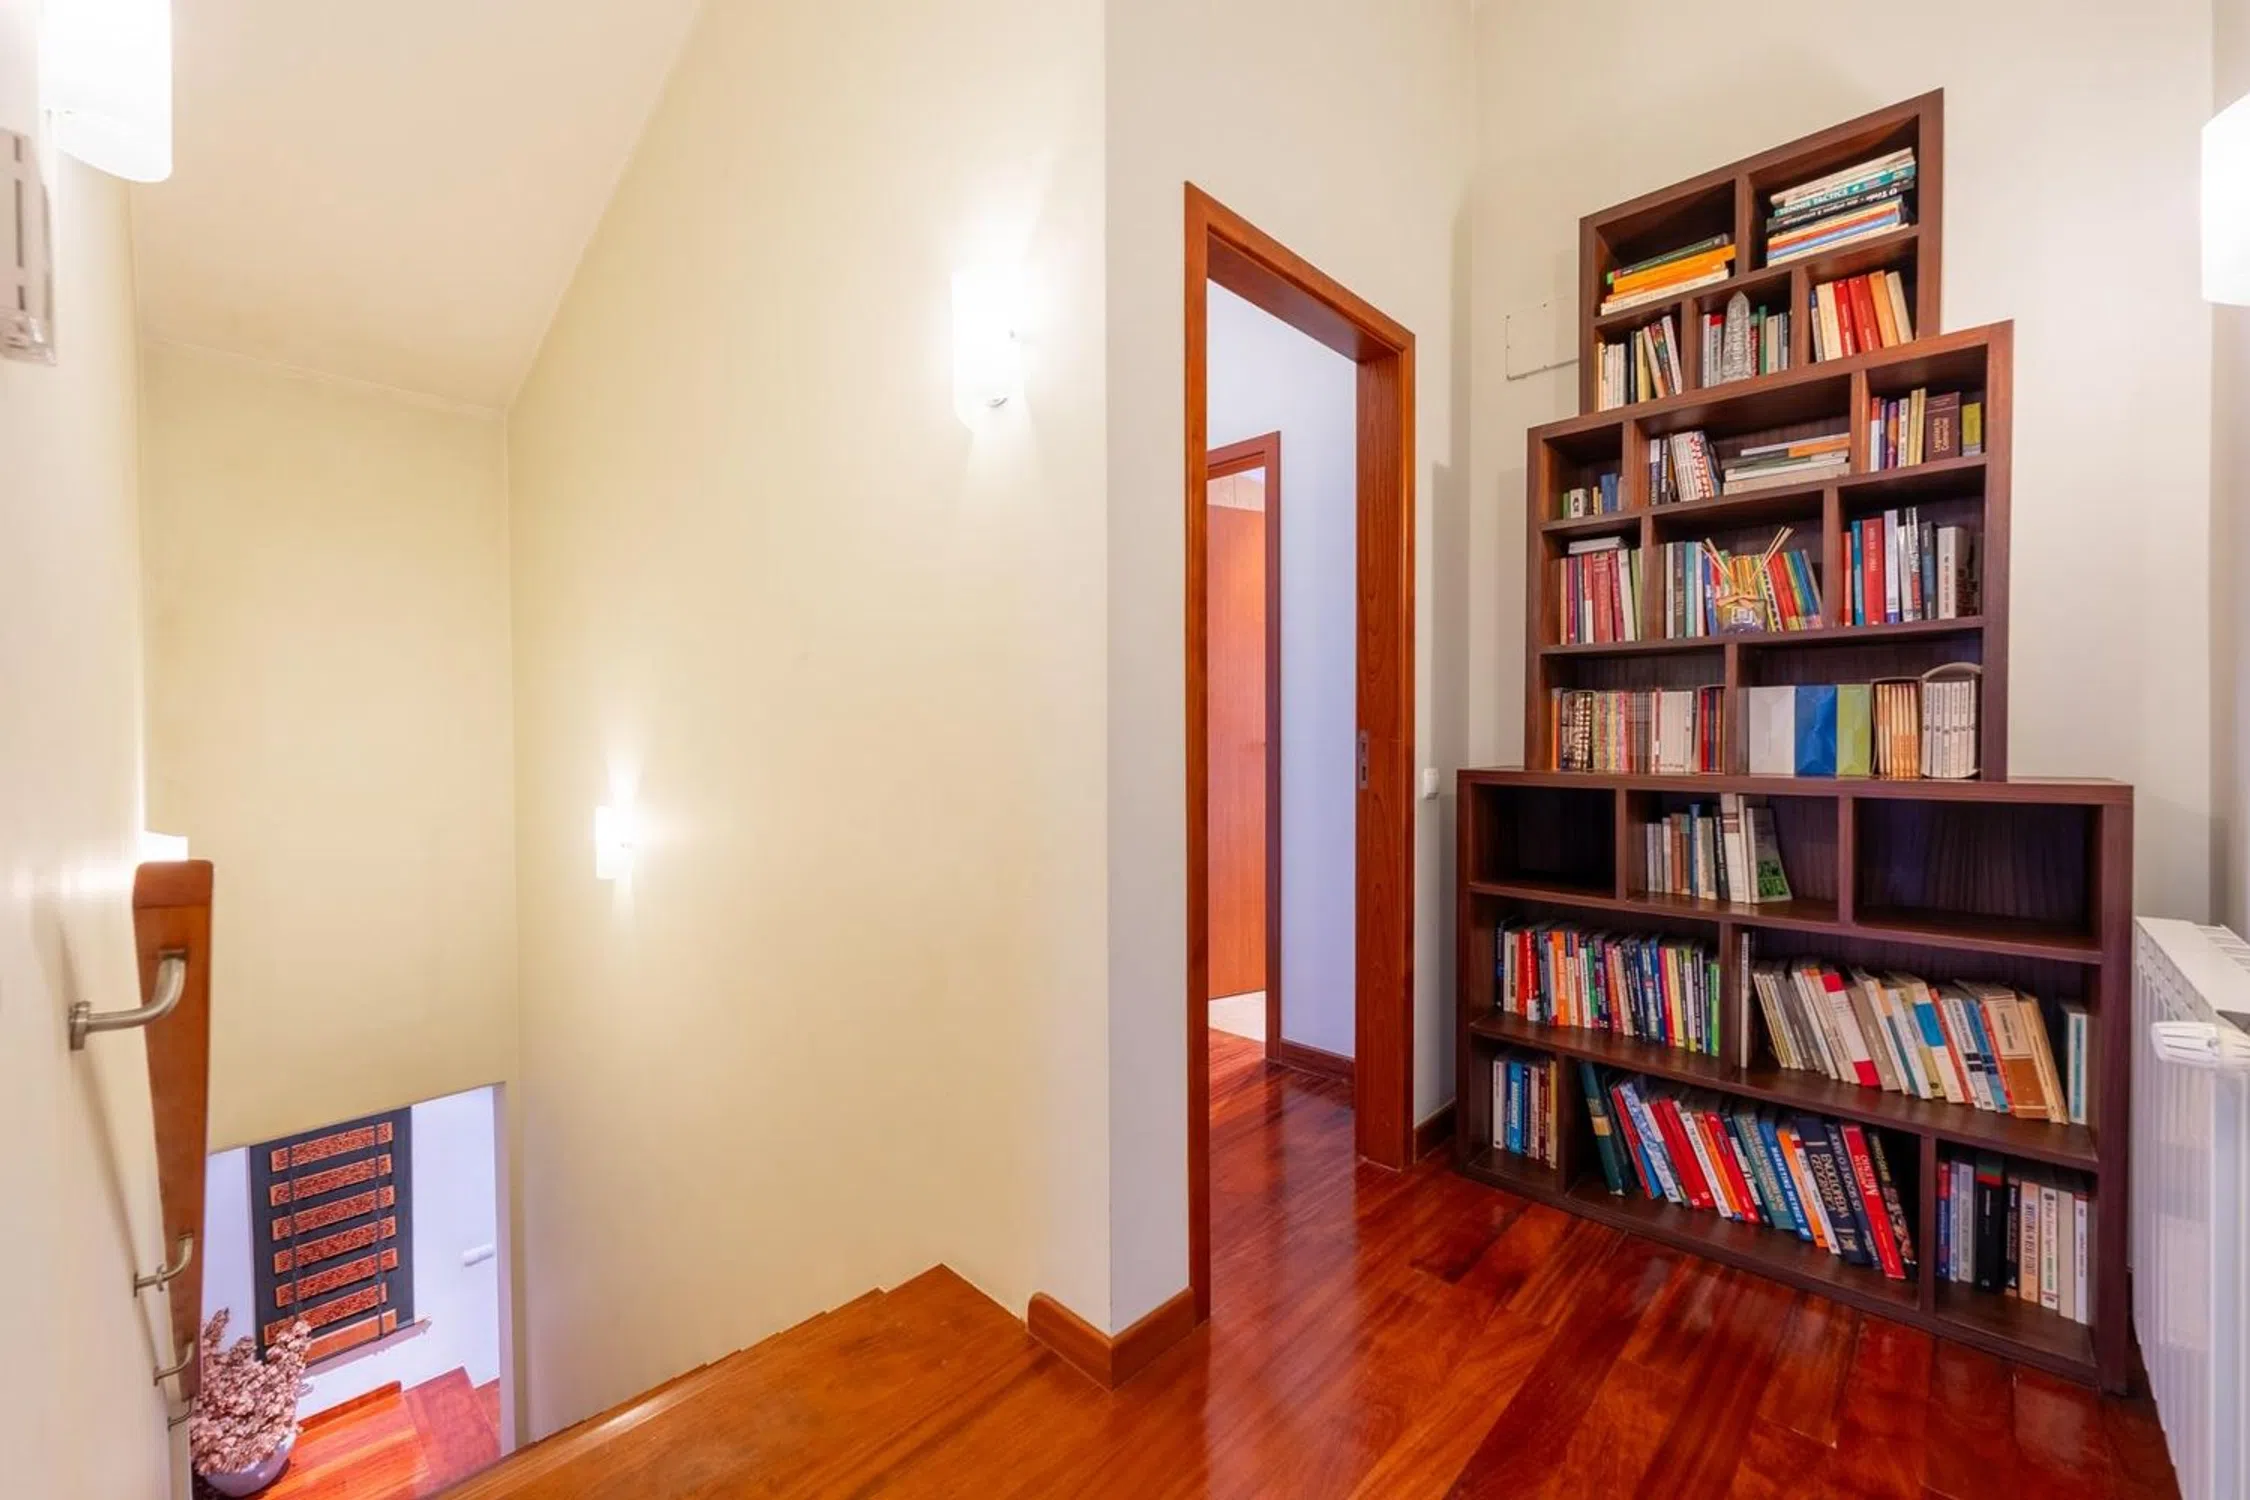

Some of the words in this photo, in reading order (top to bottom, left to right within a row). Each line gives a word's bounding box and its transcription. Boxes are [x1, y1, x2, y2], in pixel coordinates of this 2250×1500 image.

[1812, 189, 1848, 206] TACTICS
[1771, 1147, 1792, 1189] MARKETING
[1787, 1190, 1804, 1223] METRICS
